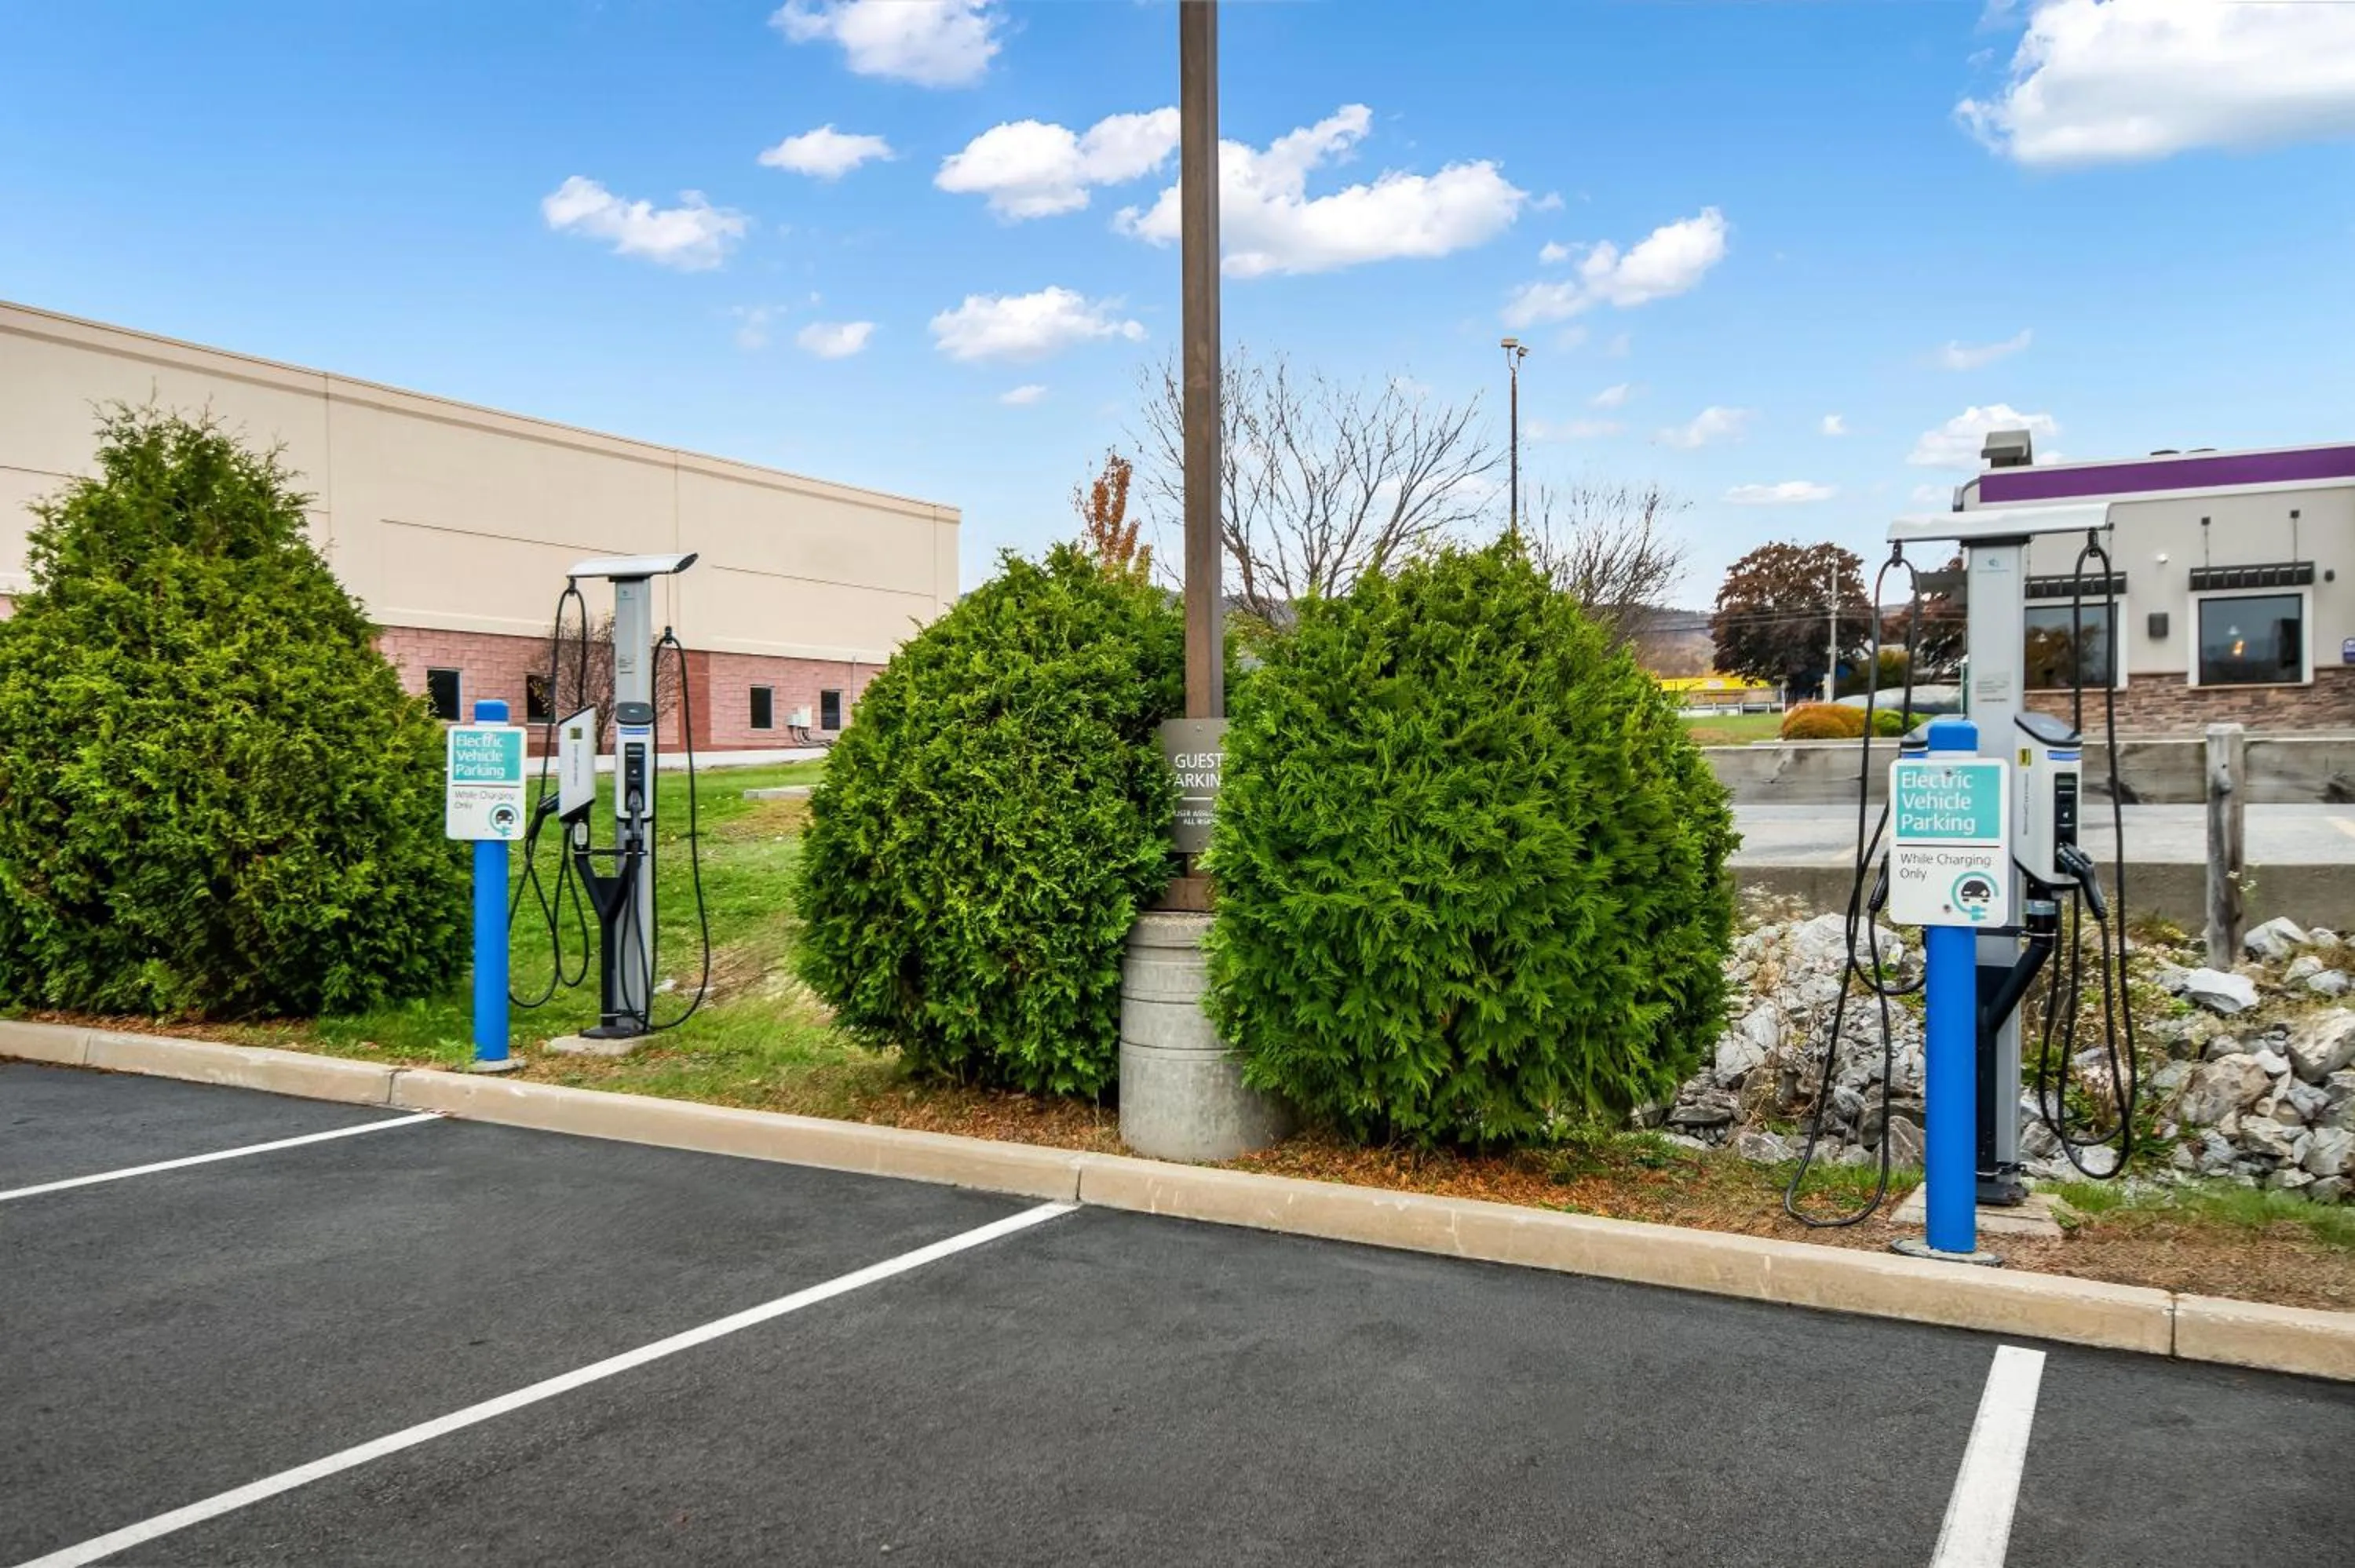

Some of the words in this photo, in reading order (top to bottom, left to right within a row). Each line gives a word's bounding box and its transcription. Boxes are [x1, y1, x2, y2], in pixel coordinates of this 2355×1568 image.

[457, 749, 503, 762] Vehicle
[1175, 753, 1225, 768] GUEST
[456, 764, 505, 779] Parking
[1172, 773, 1221, 788] ARKIN
[1901, 771, 1973, 789] Electric
[1902, 792, 1973, 811] Vehicle
[1901, 813, 1976, 836] Parking
[1900, 853, 1933, 865] While
[1937, 853, 1992, 867] Charging
[1900, 867, 1927, 882] Only
